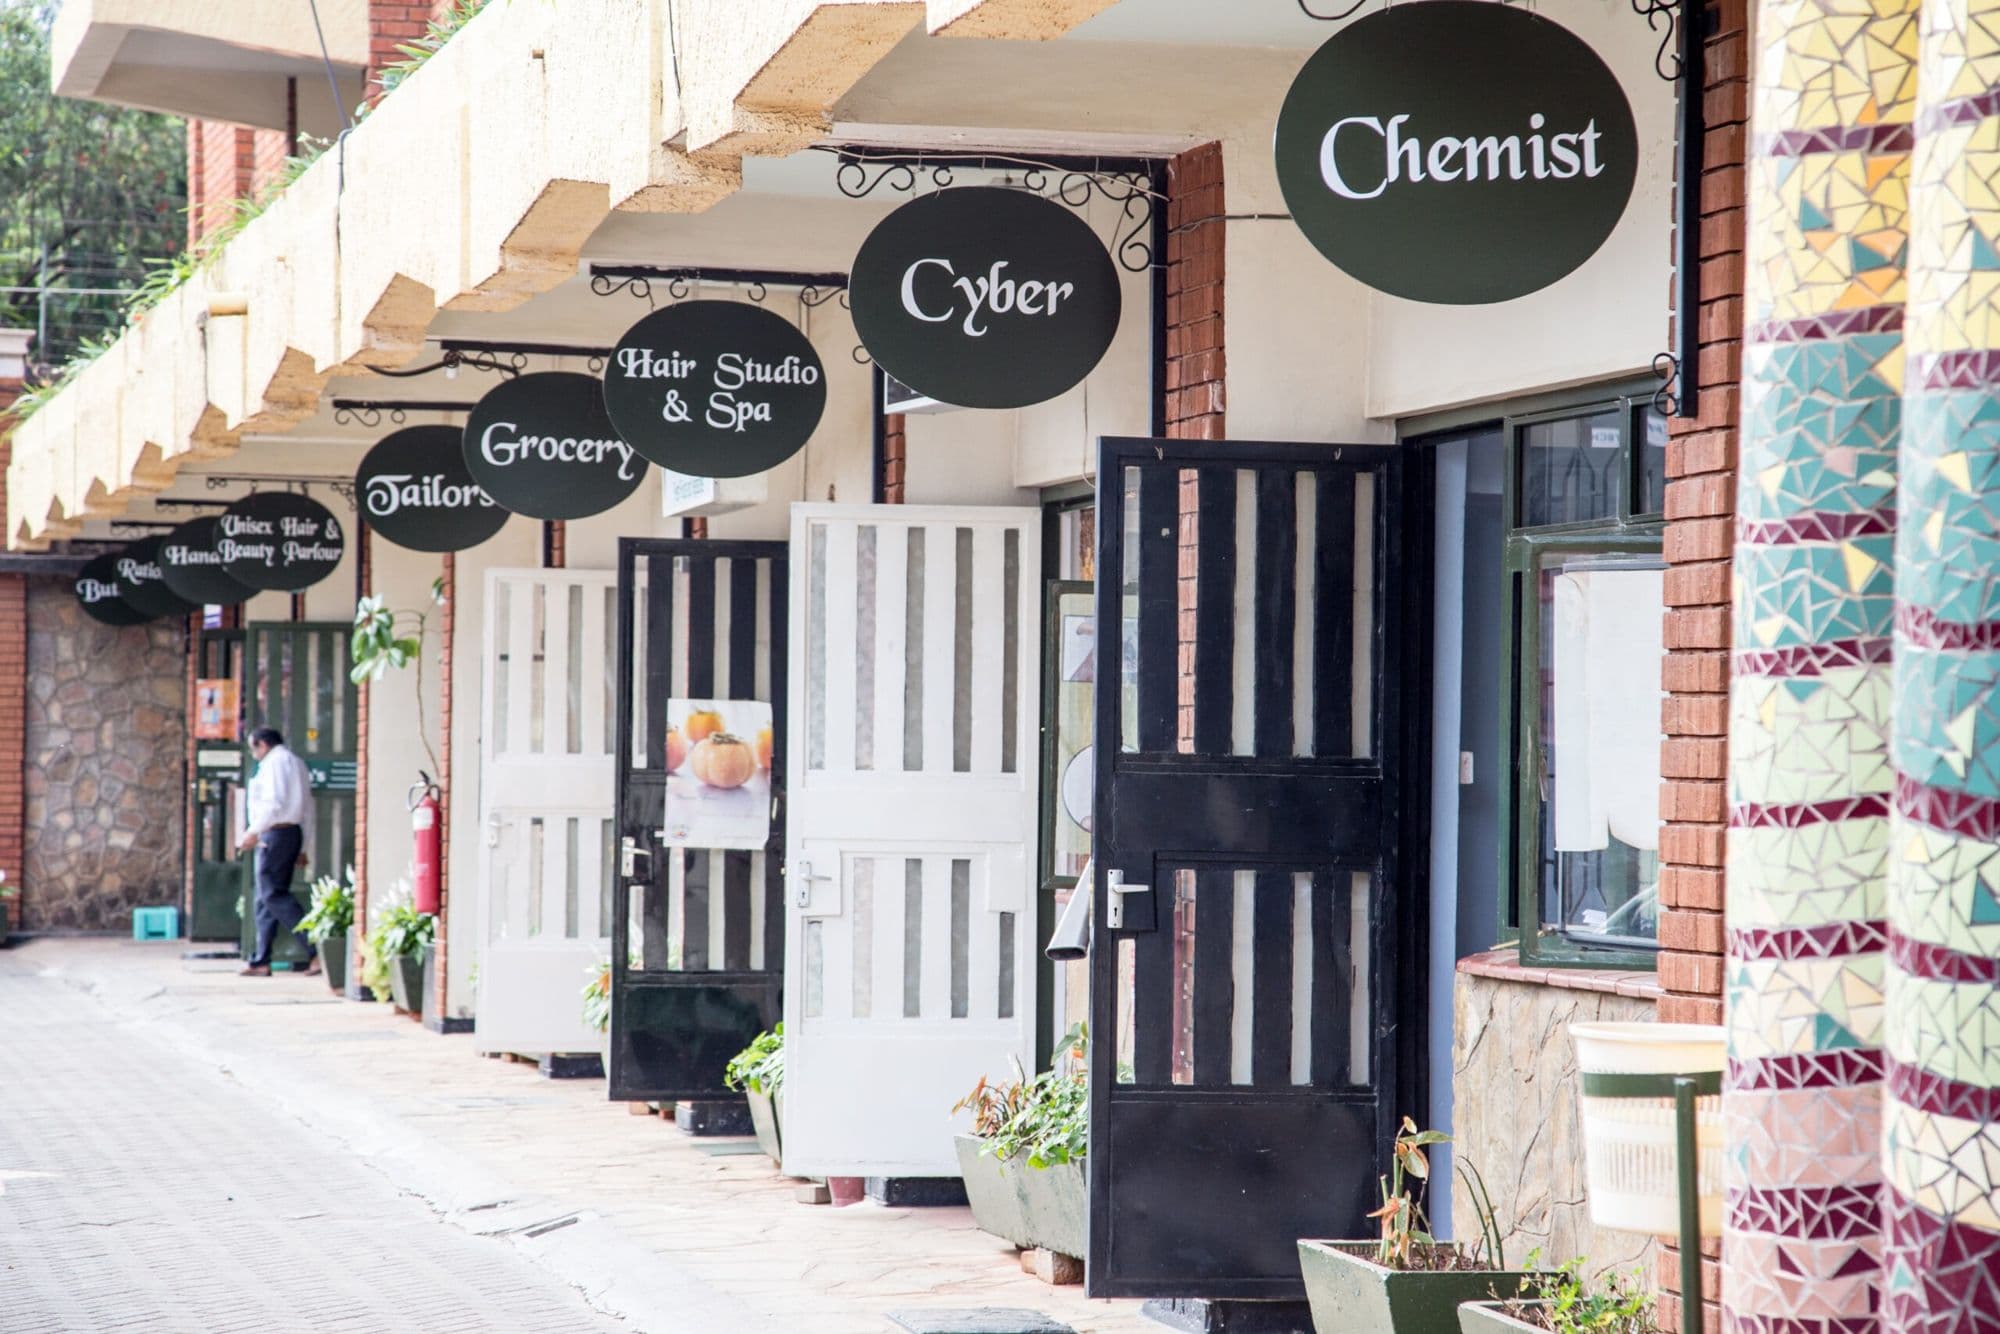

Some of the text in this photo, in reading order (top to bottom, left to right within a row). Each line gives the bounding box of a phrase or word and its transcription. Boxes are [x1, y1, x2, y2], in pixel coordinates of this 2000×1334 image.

[1320, 113, 1605, 199] Chemist
[901, 258, 1074, 336] Cyber
[617, 348, 818, 390] Hair Studio
[662, 389, 772, 432] & Spa
[481, 422, 634, 480] Grocery
[366, 474, 495, 516] Tailors
[221, 515, 339, 539] Unisex Hair &
[218, 539, 342, 567] Beauty Parlour
